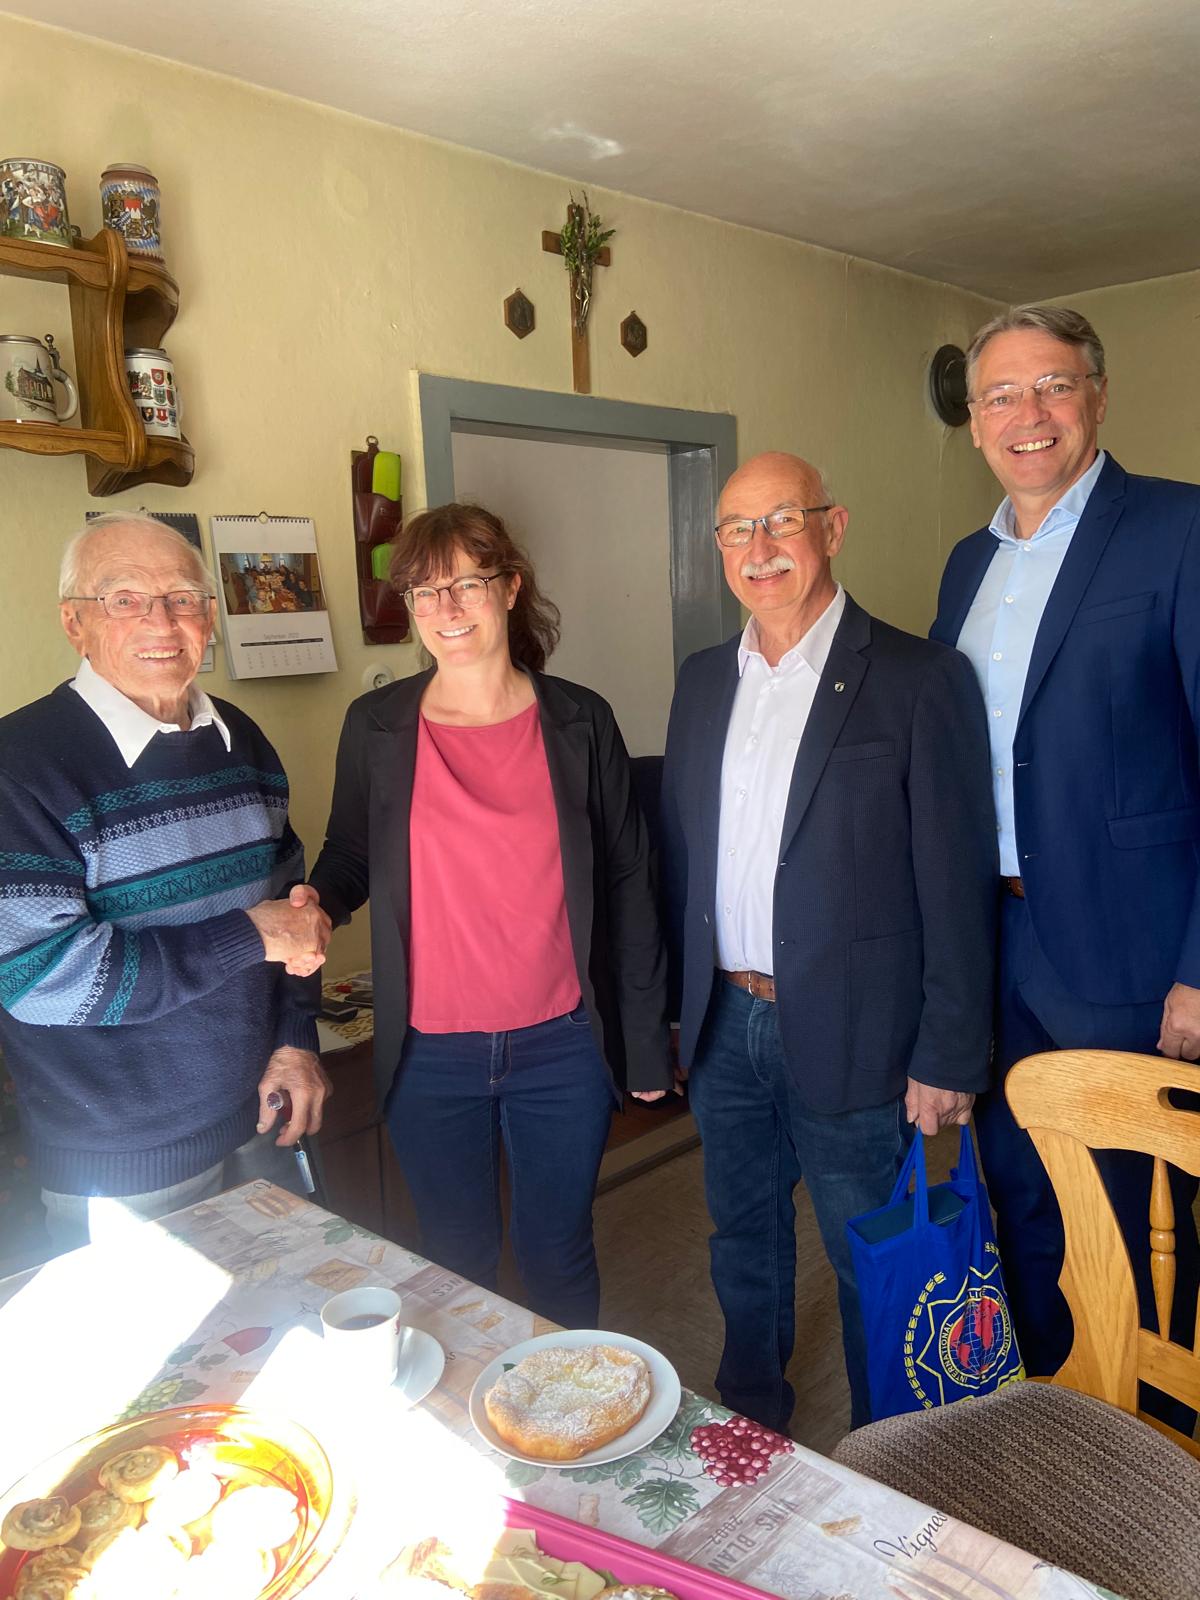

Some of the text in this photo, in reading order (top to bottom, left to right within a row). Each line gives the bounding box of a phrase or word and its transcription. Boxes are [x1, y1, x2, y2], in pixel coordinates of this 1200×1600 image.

[941, 1322, 968, 1384] INTERNATIONAL
[708, 1515, 743, 1545] 2002
[755, 1499, 799, 1531] VINS
